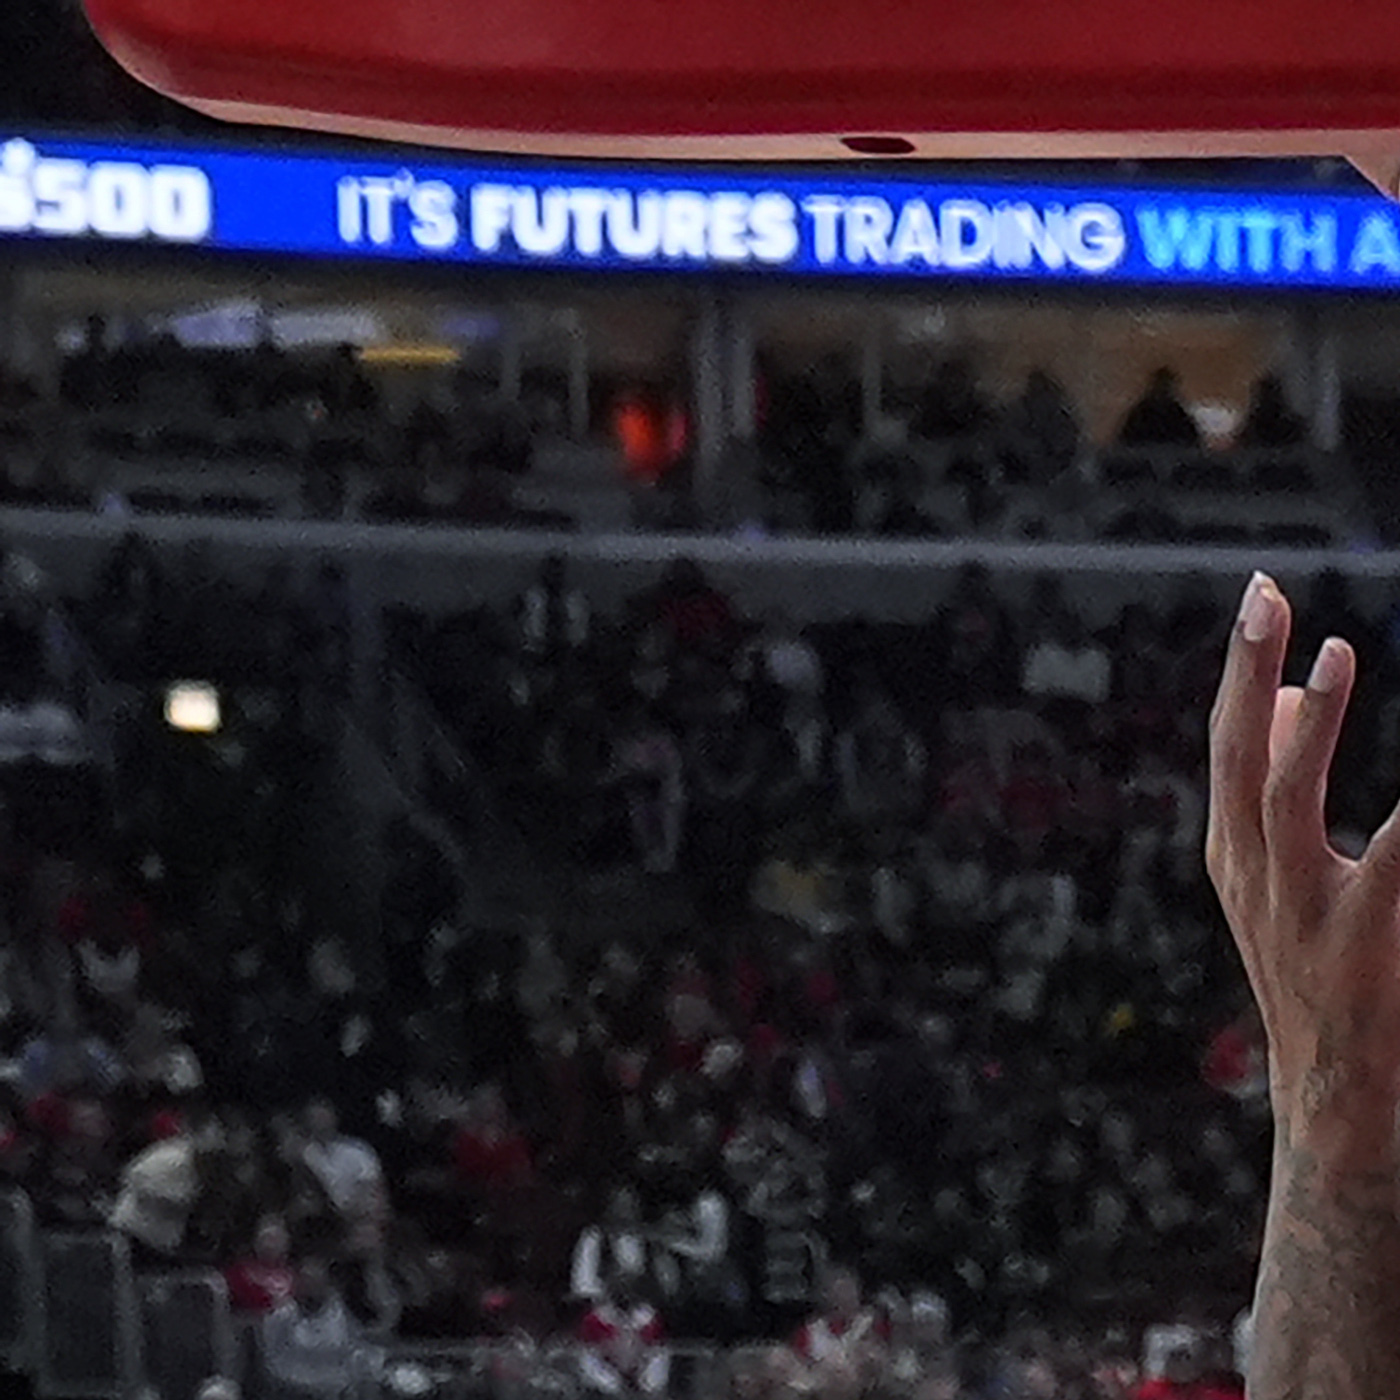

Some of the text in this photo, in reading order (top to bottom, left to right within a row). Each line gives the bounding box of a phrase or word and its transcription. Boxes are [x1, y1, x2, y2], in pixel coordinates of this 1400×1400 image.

[337, 168, 458, 248] IT'S
[470, 182, 800, 264] FUTURES
[802, 193, 1128, 270] TRADING
[1134, 205, 1338, 274] WITH
